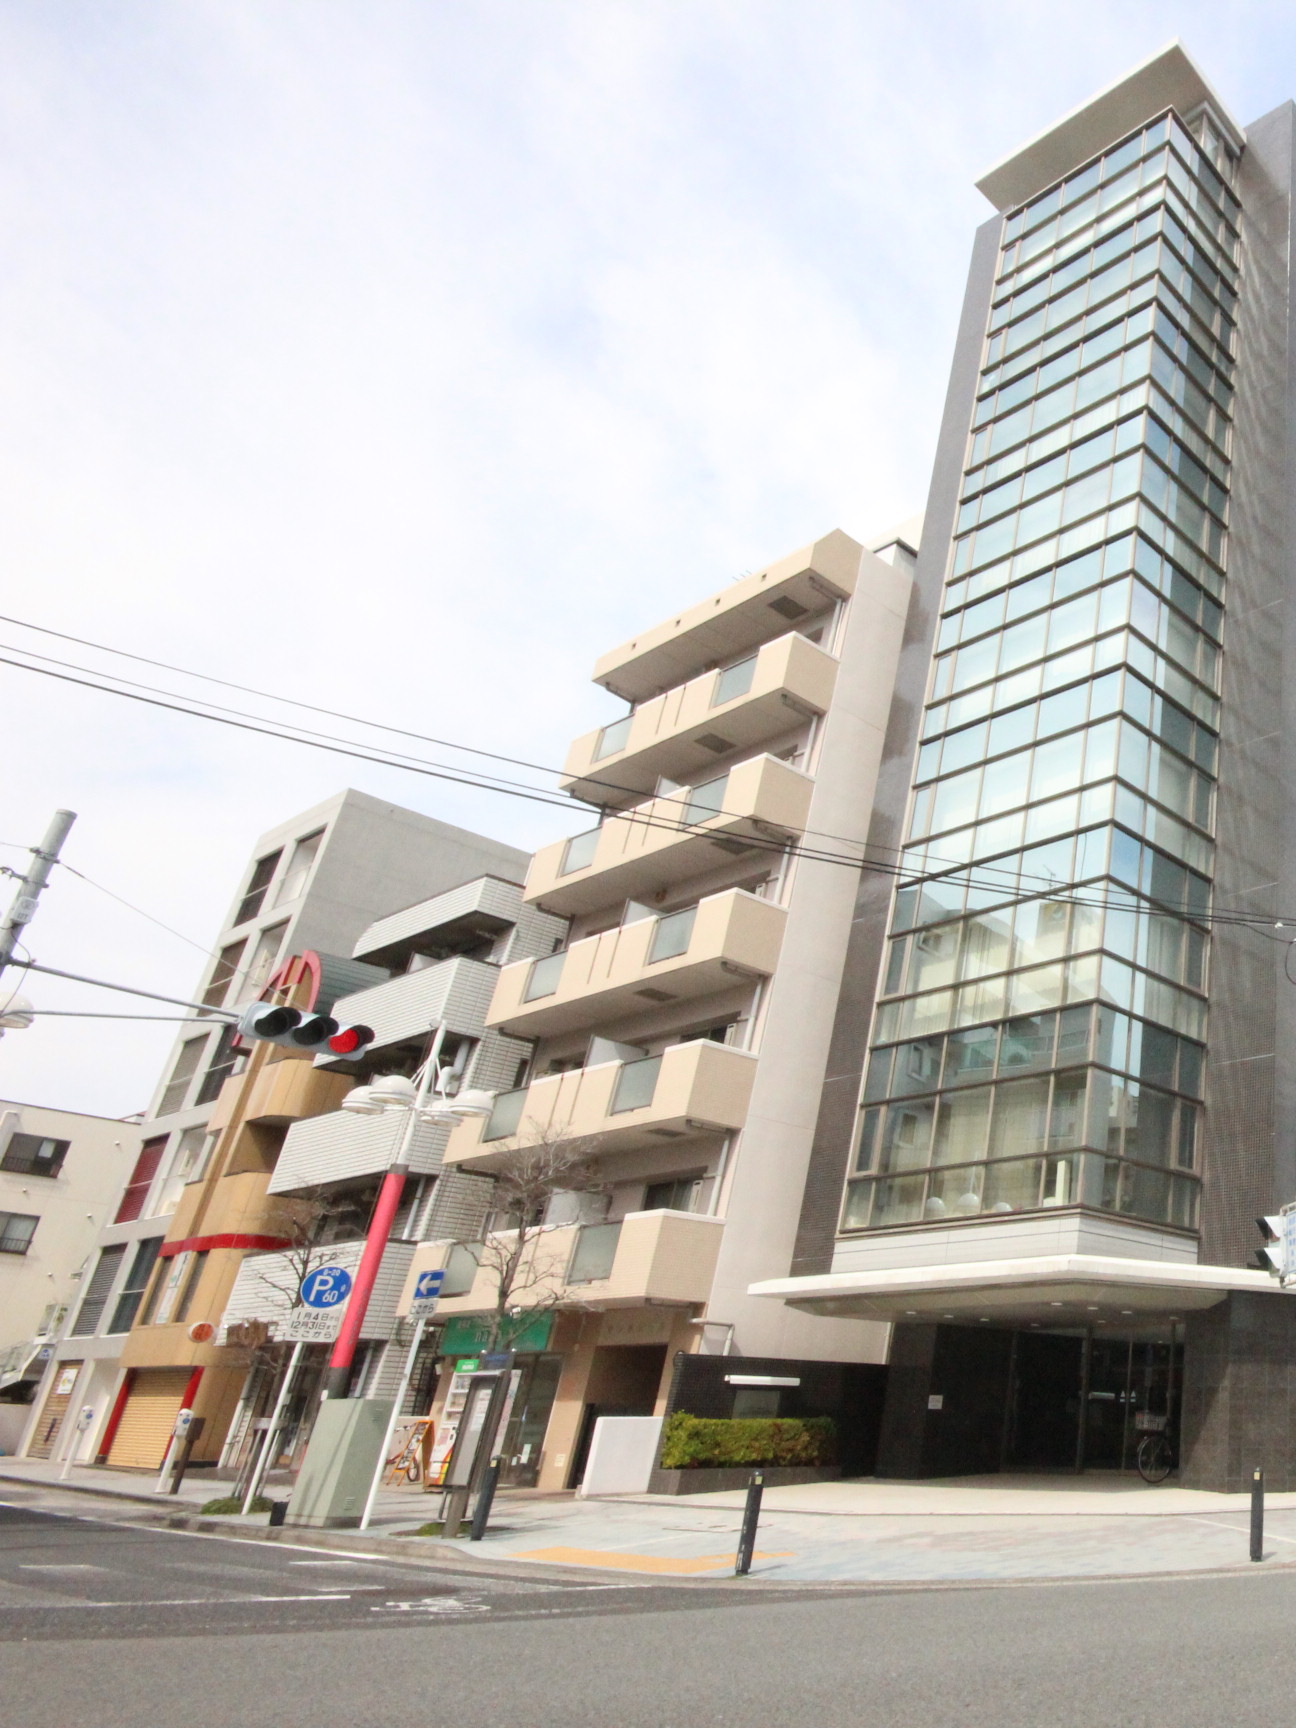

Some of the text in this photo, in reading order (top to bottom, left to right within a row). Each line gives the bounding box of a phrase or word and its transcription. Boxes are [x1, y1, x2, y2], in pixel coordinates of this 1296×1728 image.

[309, 1275, 334, 1301] P
[322, 1290, 339, 1303] 60
[290, 1330, 332, 1339] ここから
